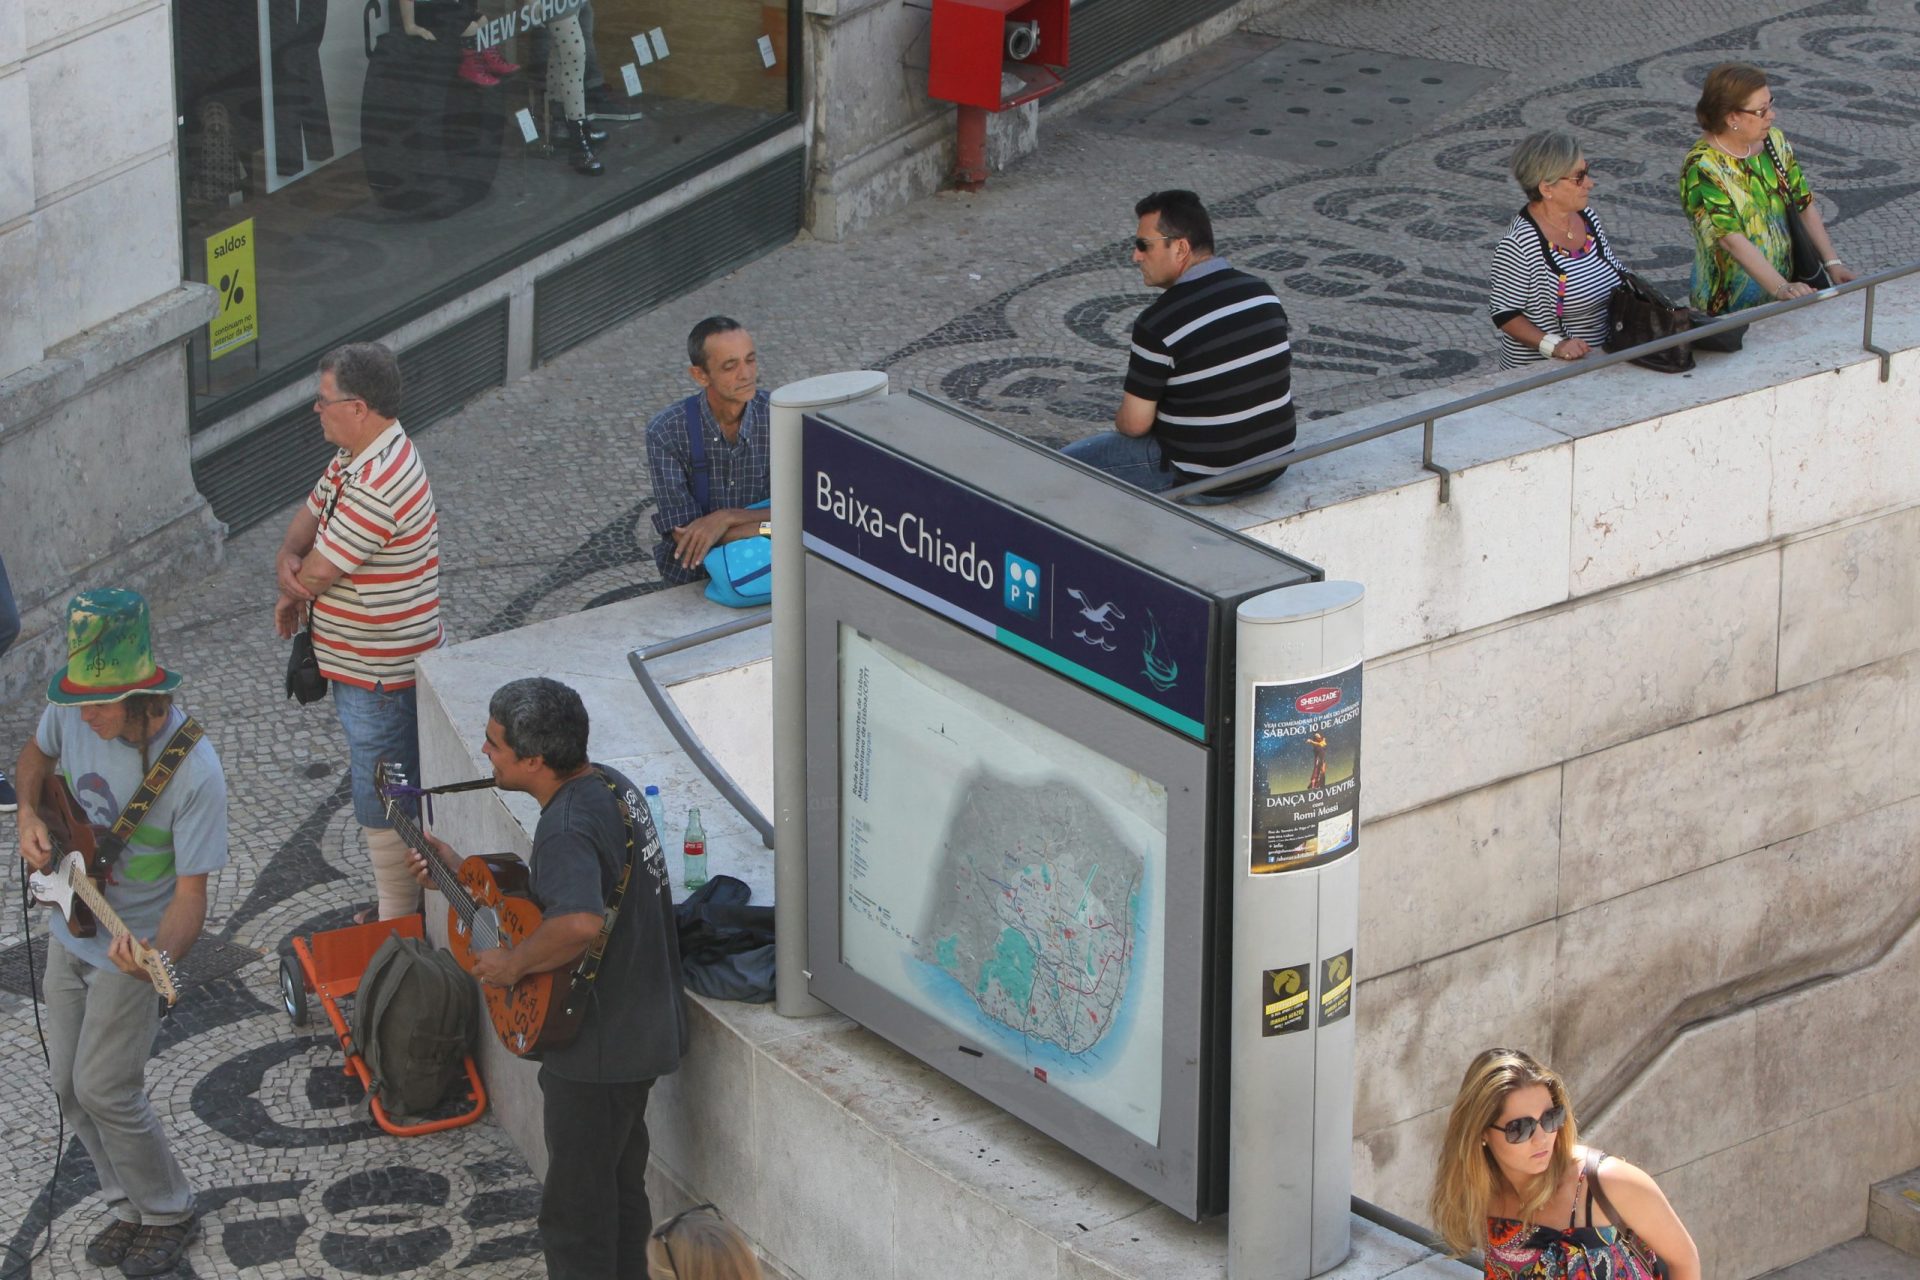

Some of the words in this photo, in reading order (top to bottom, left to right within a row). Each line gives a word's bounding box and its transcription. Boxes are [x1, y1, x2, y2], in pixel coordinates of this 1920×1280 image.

[476, 11, 516, 52] NEW
[214, 235, 247, 259] saldos
[816, 470, 994, 590] Baixa-Chiado
[856, 698, 862, 709] de
[1300, 690, 1338, 706] SHERAZADE
[860, 726, 866, 738] de
[1278, 718, 1312, 728] COMEMORAR
[1323, 712, 1332, 720] MÊS
[1309, 723, 1318, 732] 10
[1320, 720, 1332, 730] DE
[1333, 708, 1359, 726] AGOSTO
[854, 711, 862, 759] transportes
[853, 762, 859, 772] de
[857, 740, 866, 800] Metropolitano
[1266, 795, 1305, 808] DANÇA
[1308, 790, 1323, 801] DO
[1325, 778, 1355, 797] VENTRE
[1294, 809, 1316, 821] Romi
[1318, 803, 1339, 816] Mossi
